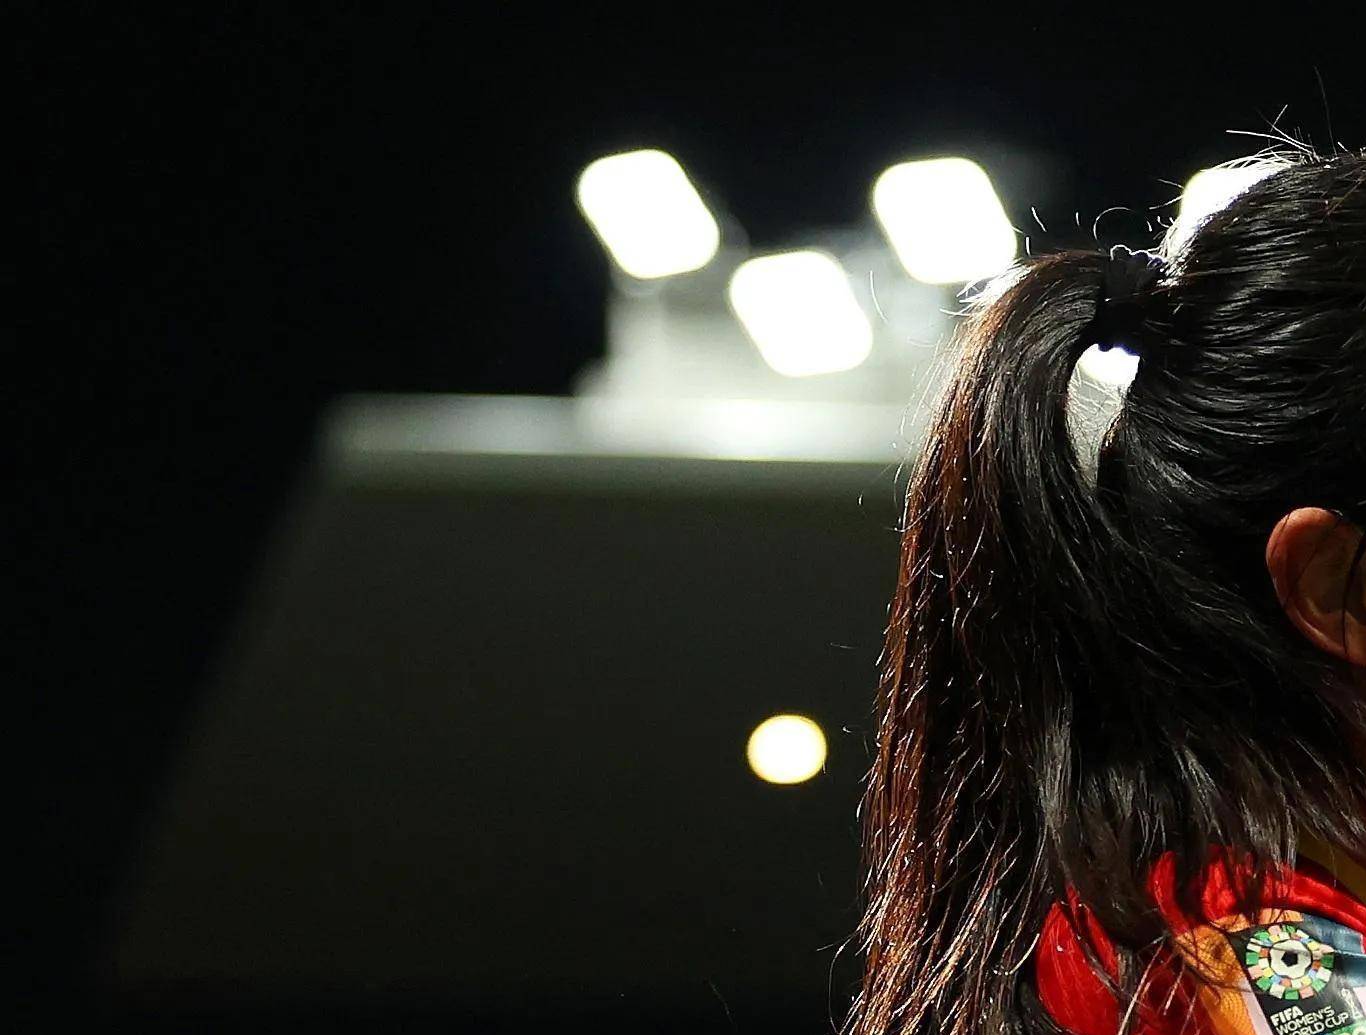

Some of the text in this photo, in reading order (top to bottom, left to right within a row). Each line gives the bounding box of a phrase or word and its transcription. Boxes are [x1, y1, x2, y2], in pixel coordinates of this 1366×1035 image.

[1270, 1005, 1304, 1026] FIFA
[1276, 1005, 1336, 1035] WOMEN'S
[1325, 1012, 1350, 1029] CUP
